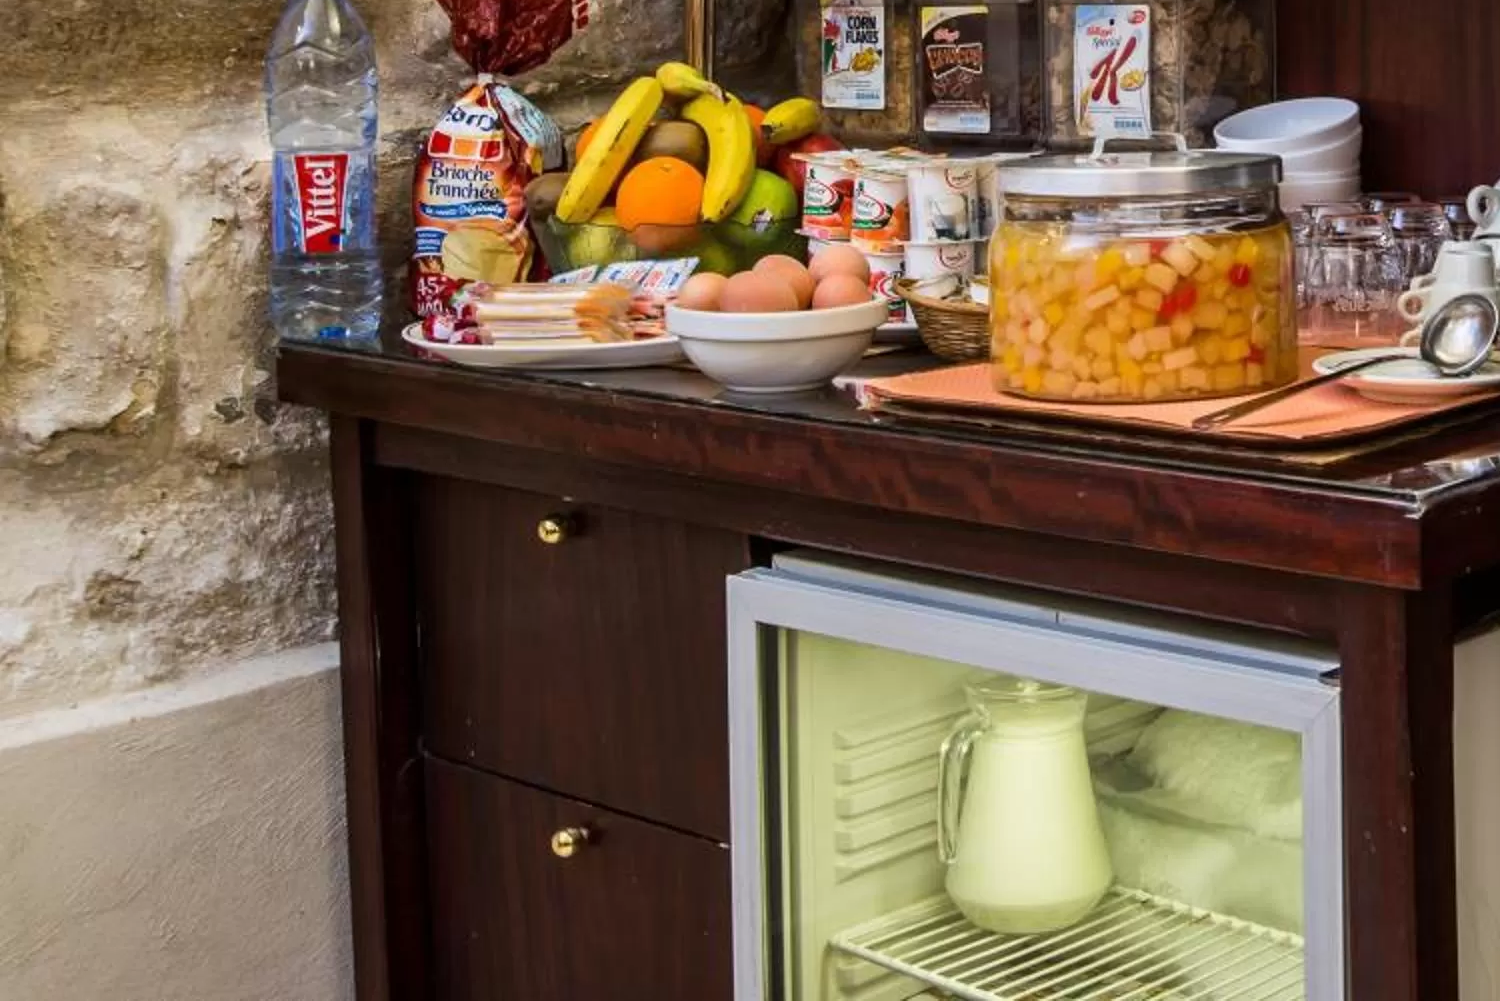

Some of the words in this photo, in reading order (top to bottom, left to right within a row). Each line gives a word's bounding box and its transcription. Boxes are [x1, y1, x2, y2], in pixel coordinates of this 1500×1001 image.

[847, 16, 877, 30] CORN
[845, 30, 879, 45] FLAKES
[1090, 36, 1137, 105] K
[431, 160, 495, 182] Brioche
[304, 157, 337, 239] Vittel
[427, 178, 499, 200] Tranchée
